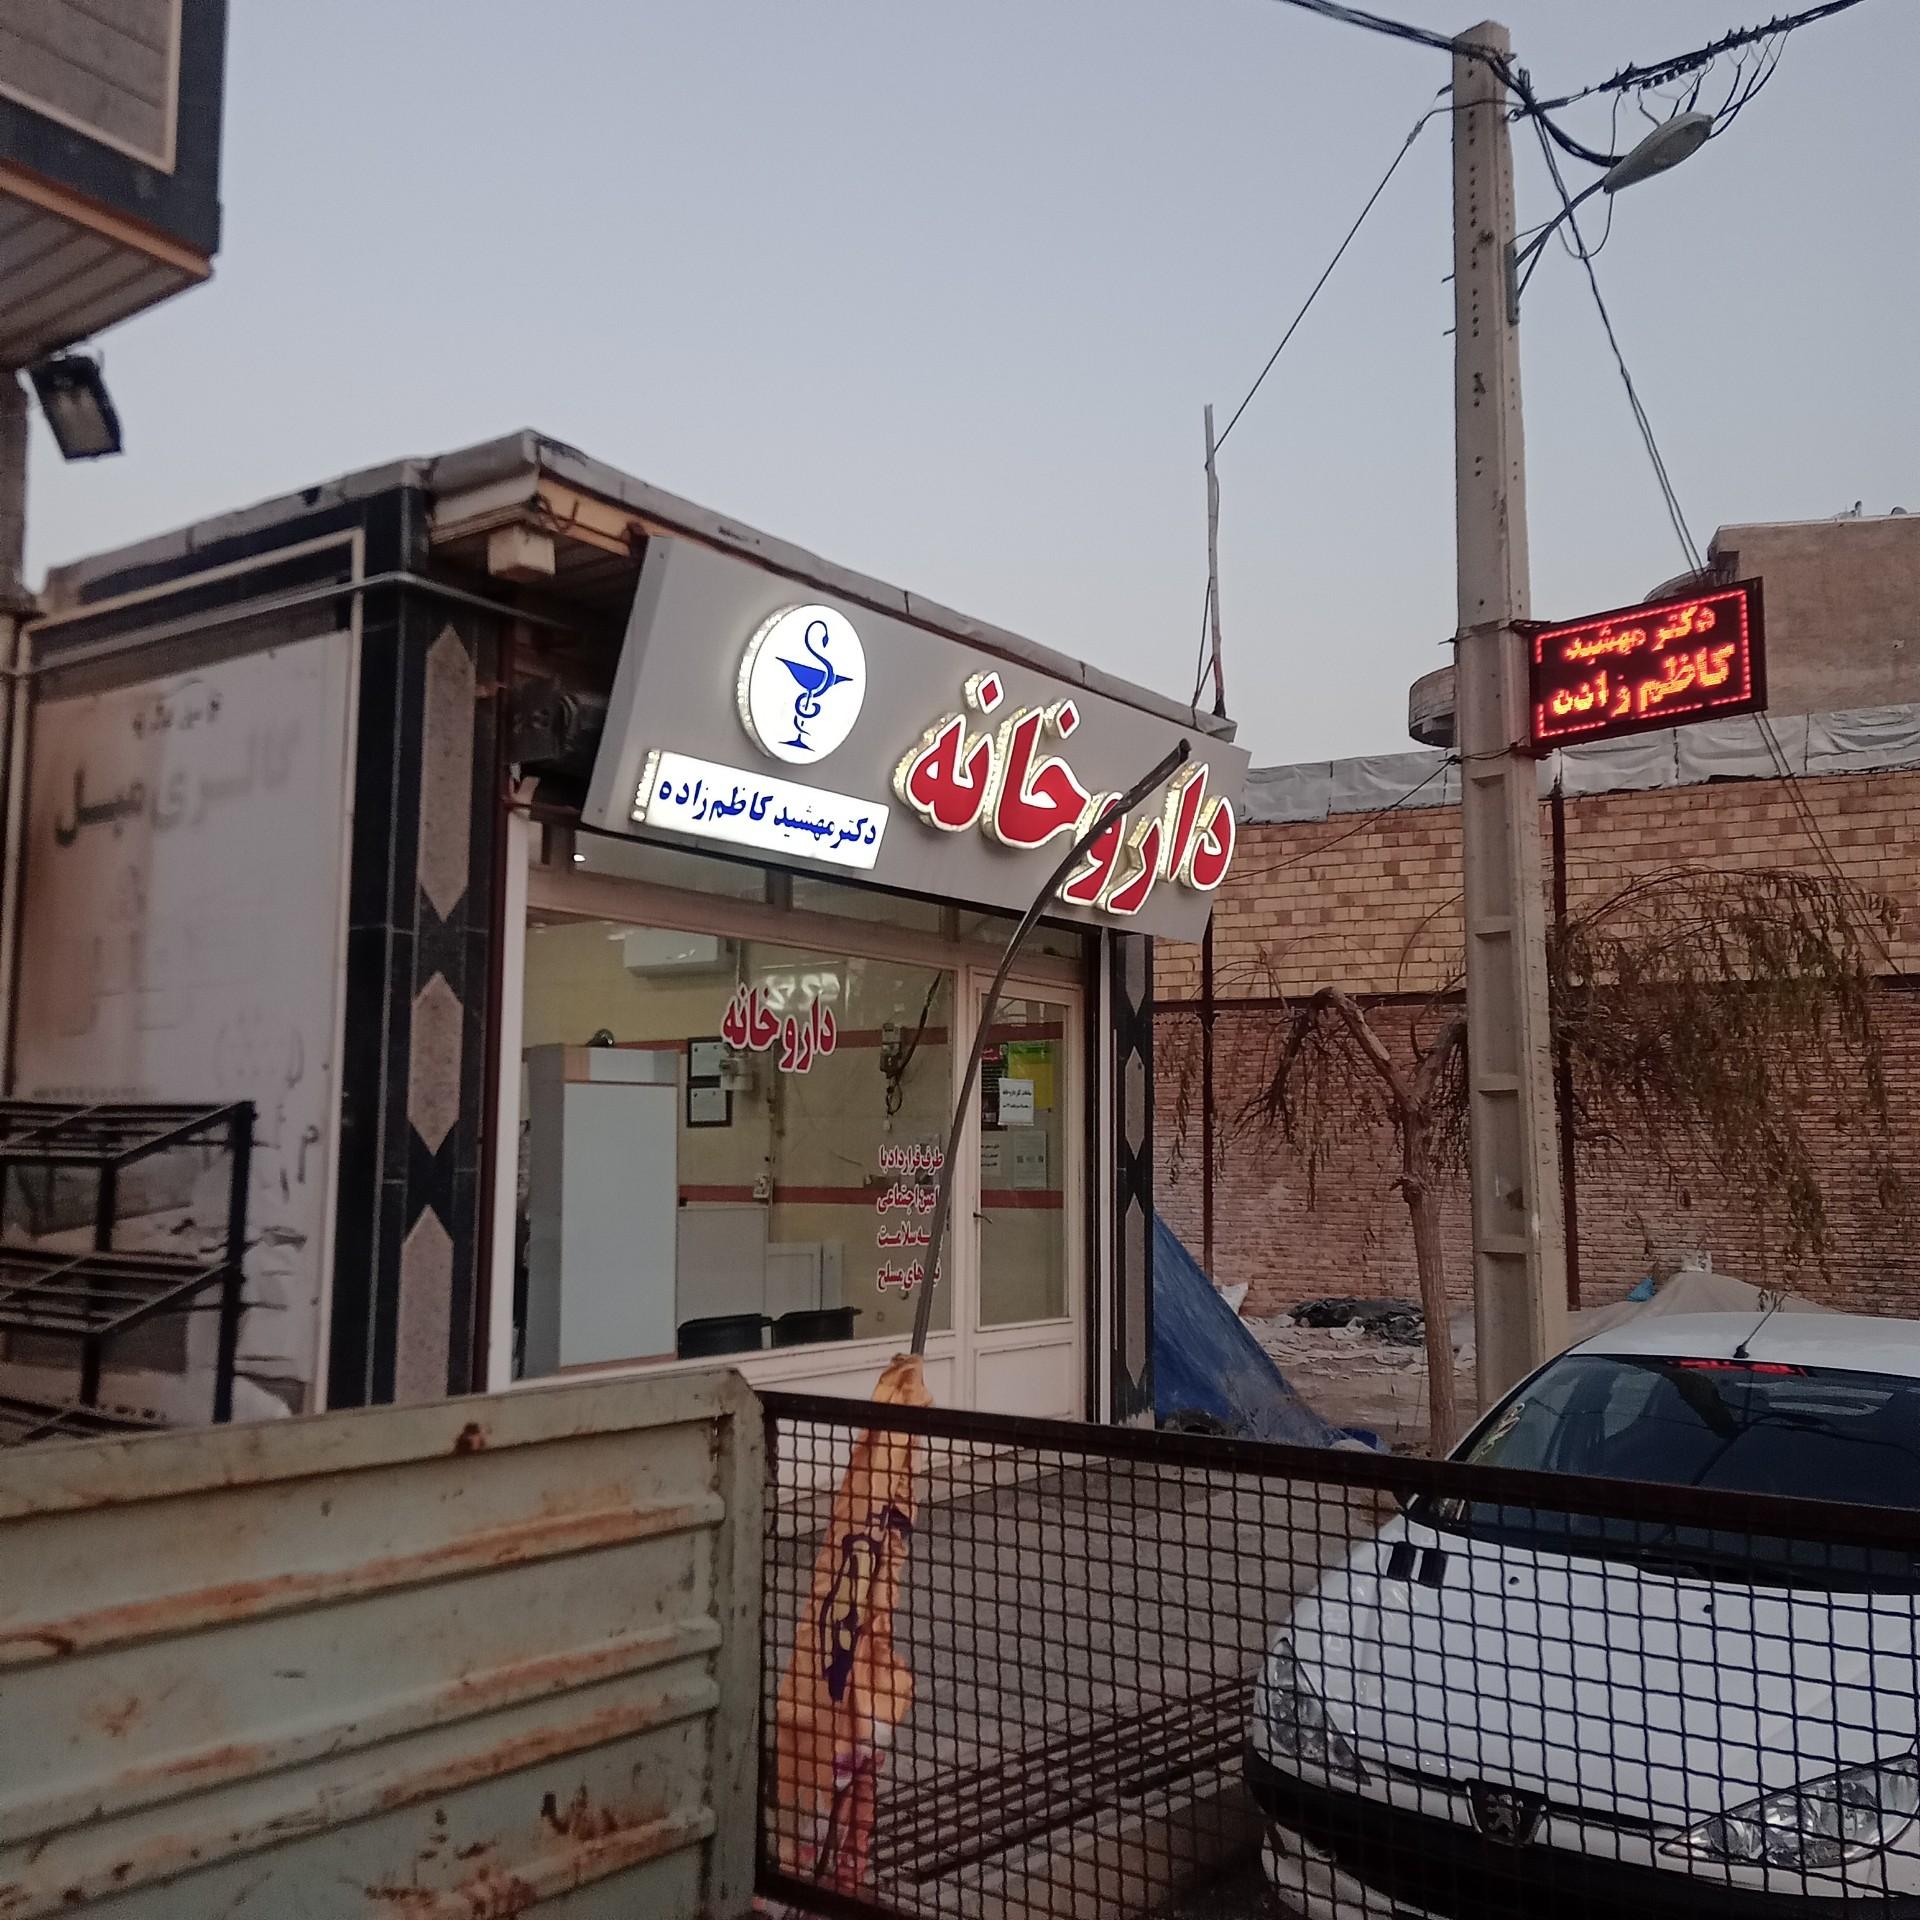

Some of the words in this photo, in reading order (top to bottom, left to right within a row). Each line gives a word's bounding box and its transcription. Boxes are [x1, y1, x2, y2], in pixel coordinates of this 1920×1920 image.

[1564, 624, 1647, 666] مهشید
[1652, 604, 1716, 652] دکتر
[1638, 643, 1735, 712] کاظم
[894, 670, 1235, 916] داروخانه
[773, 805, 836, 841] مهشید
[829, 817, 877, 850] دکتر
[721, 983, 837, 1073] داروخانه
[921, 1144, 945, 1176] طرف
[877, 1220, 918, 1248] سلامت
[877, 1259, 905, 1292] مسلح
